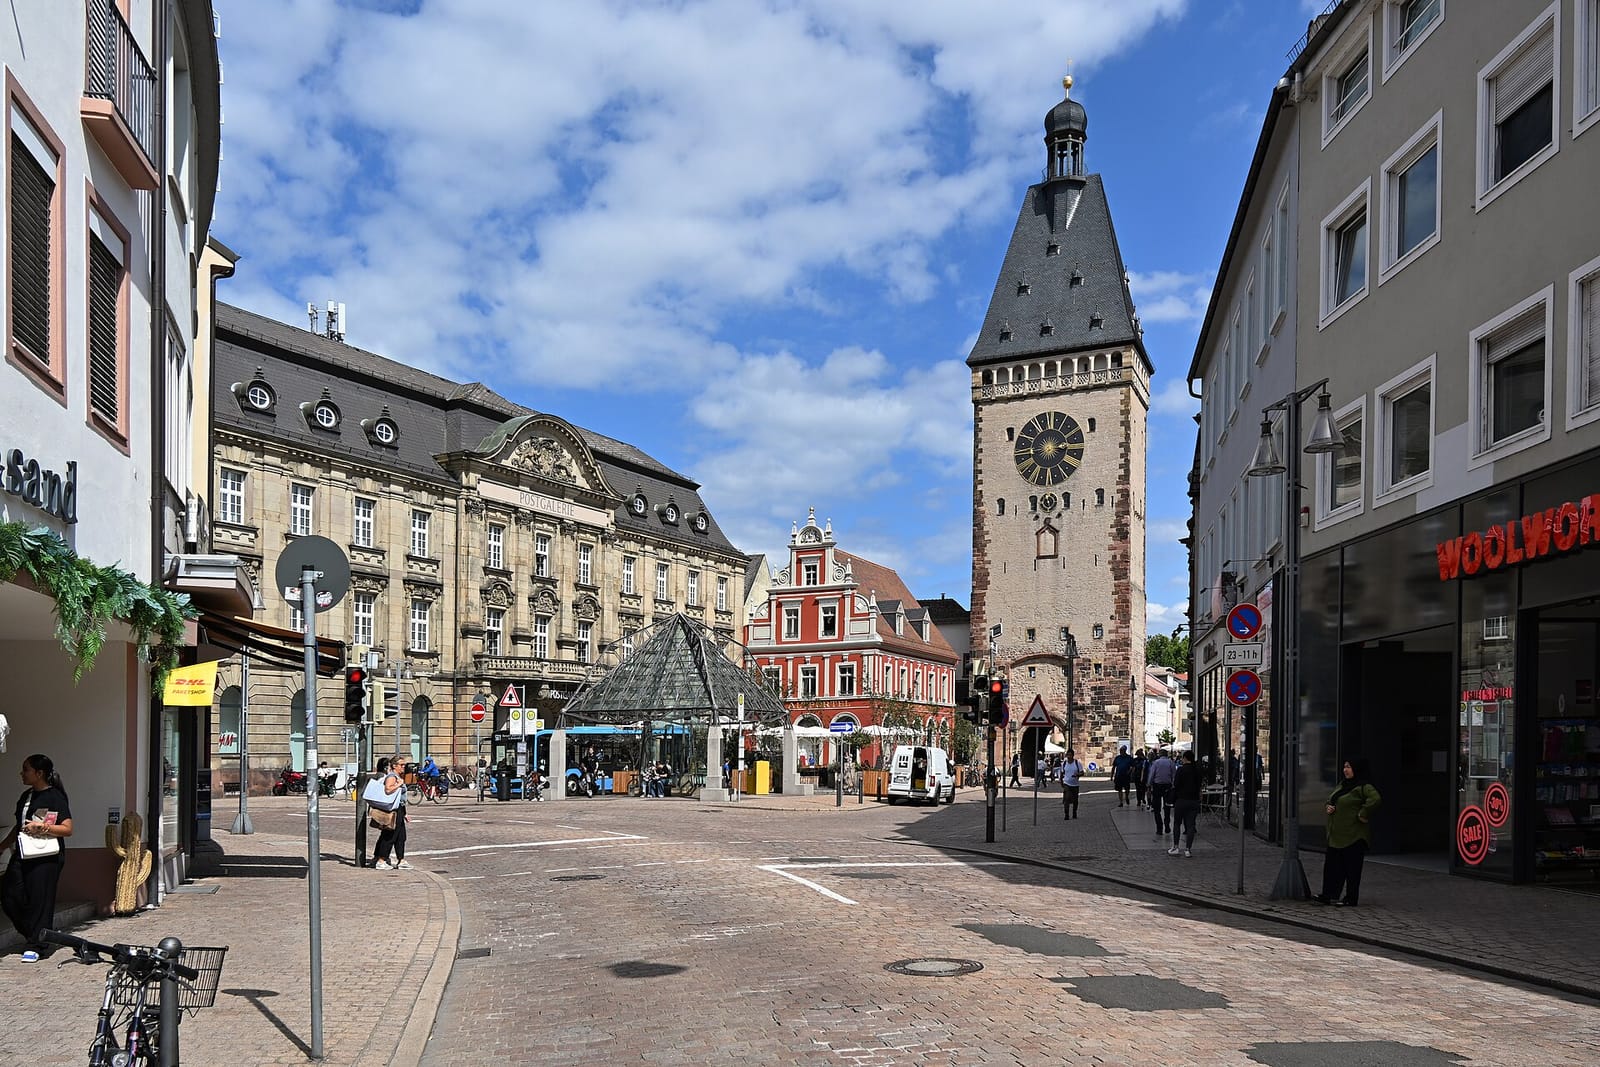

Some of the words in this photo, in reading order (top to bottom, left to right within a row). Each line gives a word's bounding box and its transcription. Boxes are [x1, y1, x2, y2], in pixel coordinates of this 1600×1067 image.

[0, 448, 78, 524] sand
[519, 491, 575, 517] POSTGALERIE
[1463, 824, 1482, 843] SALE
